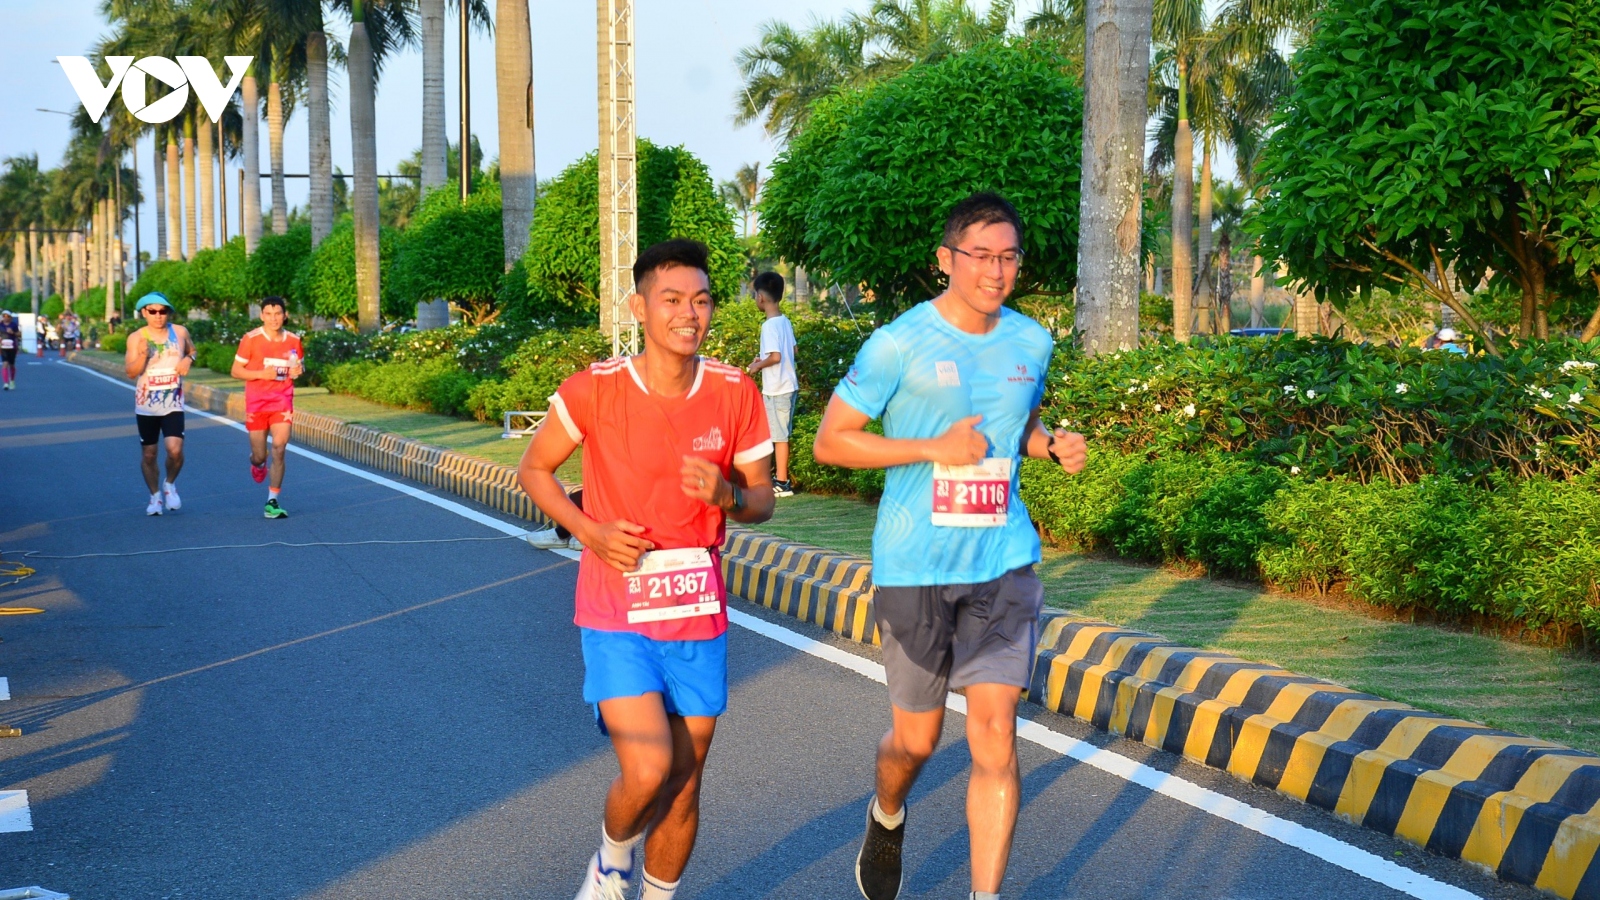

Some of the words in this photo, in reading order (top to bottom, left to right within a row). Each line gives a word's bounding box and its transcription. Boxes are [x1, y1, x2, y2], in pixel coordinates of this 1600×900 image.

[154, 374, 175, 384] 21077
[955, 483, 1005, 505] 21116
[628, 576, 641, 588] 21
[647, 571, 708, 599] 21367
[629, 586, 642, 594] KM
